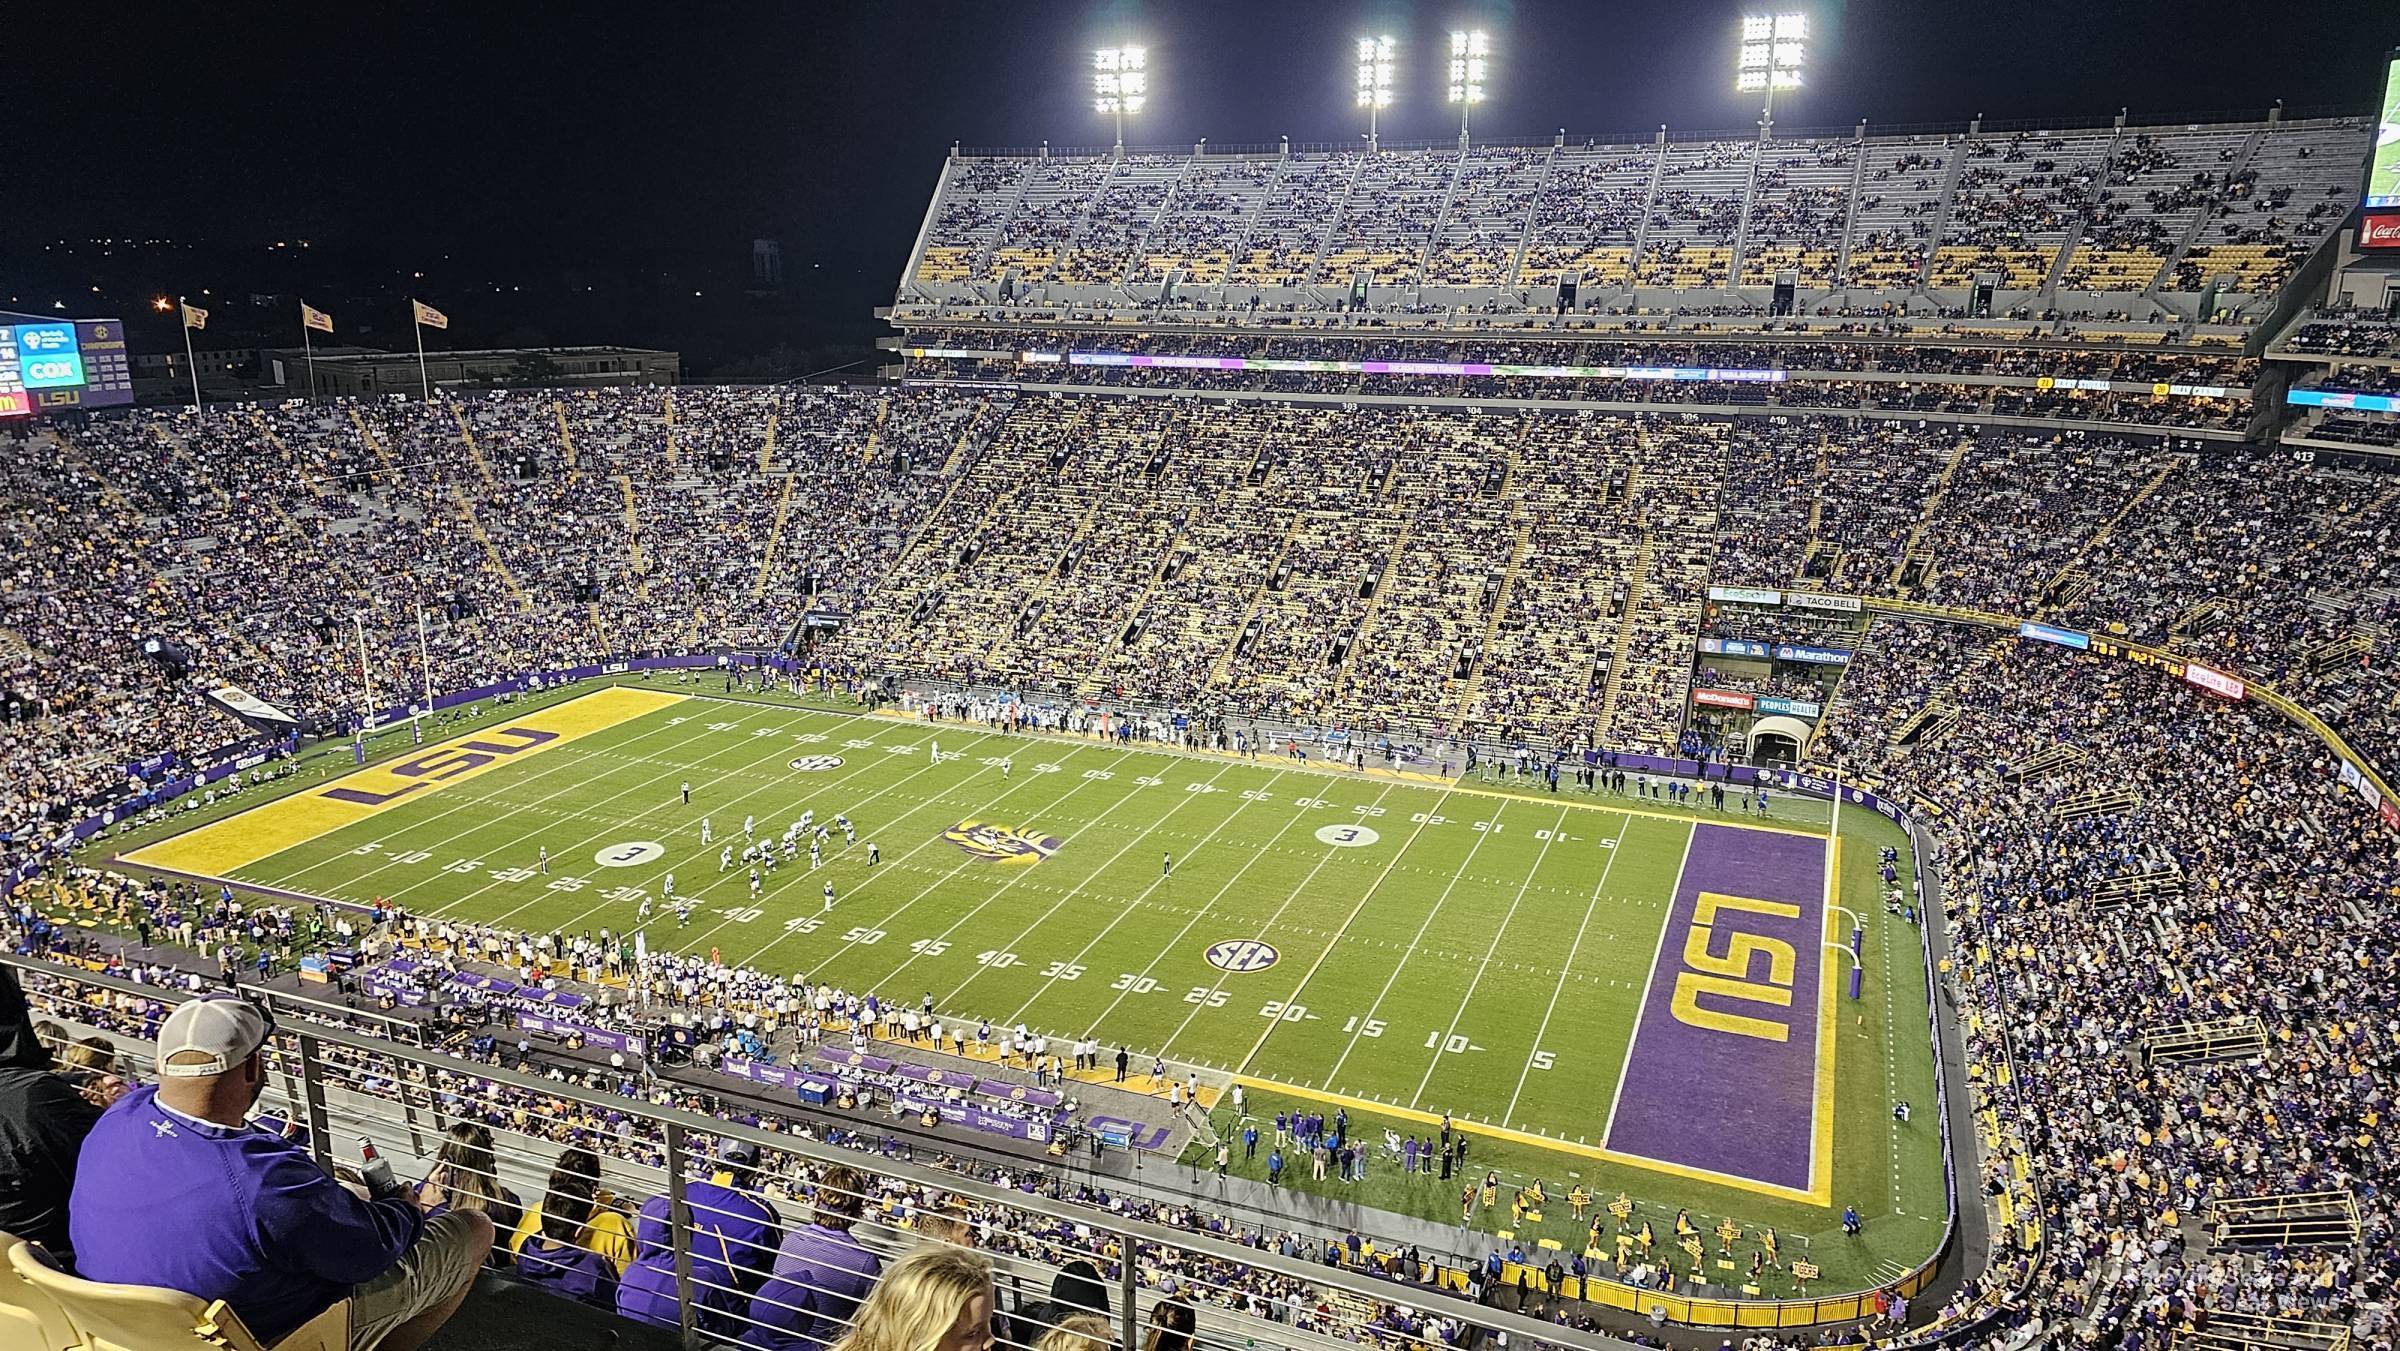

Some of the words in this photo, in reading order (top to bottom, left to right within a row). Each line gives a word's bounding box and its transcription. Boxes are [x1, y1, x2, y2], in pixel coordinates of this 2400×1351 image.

[29, 361, 74, 379] COX
[716, 385, 731, 394] 241
[823, 385, 839, 393] 242
[1048, 391, 1062, 399] 300
[38, 390, 81, 407] LSU
[1342, 402, 1358, 412] 303
[1467, 406, 1482, 415] 304
[1577, 410, 1594, 419] 305
[1769, 416, 1788, 425] 410
[2293, 451, 2315, 462] 413
[1722, 589, 1766, 599] EcoSport
[1807, 597, 1832, 606] TACO
[1833, 599, 1858, 609] BELL
[1794, 650, 1849, 663] Marathon
[602, 662, 629, 675] LSU
[1696, 692, 1750, 706] McDonald's
[1760, 699, 1790, 711] PEOPLES
[1791, 702, 1818, 715] HEALTH
[708, 722, 738, 732] 10
[751, 728, 783, 737] 15
[797, 733, 829, 743] 20
[841, 739, 874, 749] 25
[888, 744, 921, 755] 30
[319, 726, 562, 806] LSU
[790, 754, 844, 771] SEC
[1031, 763, 1063, 772] 45
[1080, 770, 1116, 780] 50
[1132, 776, 1165, 786] 45
[1185, 782, 1219, 793] 40
[1238, 790, 1275, 801] 35
[1294, 798, 1332, 809] 30
[1351, 805, 1388, 817] 25
[1410, 813, 1447, 825] 20
[1471, 821, 1505, 834] 15
[1335, 827, 1361, 843] 3
[1534, 829, 1567, 842] 10
[353, 844, 384, 856] 5
[1599, 838, 1618, 850] 5
[391, 850, 433, 864] 10
[610, 847, 648, 862] 3
[442, 858, 485, 873] 15
[491, 867, 538, 883] 20
[545, 877, 593, 892] 25
[600, 886, 648, 902] 30
[721, 906, 765, 924] 40
[784, 917, 826, 935] 45
[840, 926, 888, 946] 50
[910, 938, 953, 957] 45
[976, 950, 1019, 968] 40
[1208, 941, 1280, 972] SEC
[1040, 961, 1088, 981] 35
[1670, 891, 1801, 1043] LSU
[1110, 973, 1158, 995] 30
[1183, 987, 1233, 1007] 25
[1259, 1000, 1309, 1023] 20
[1342, 1016, 1389, 1038] 15
[1424, 1031, 1471, 1054] 10
[1531, 1050, 1558, 1070] 5
[1793, 1263, 1818, 1278] TIGERS
